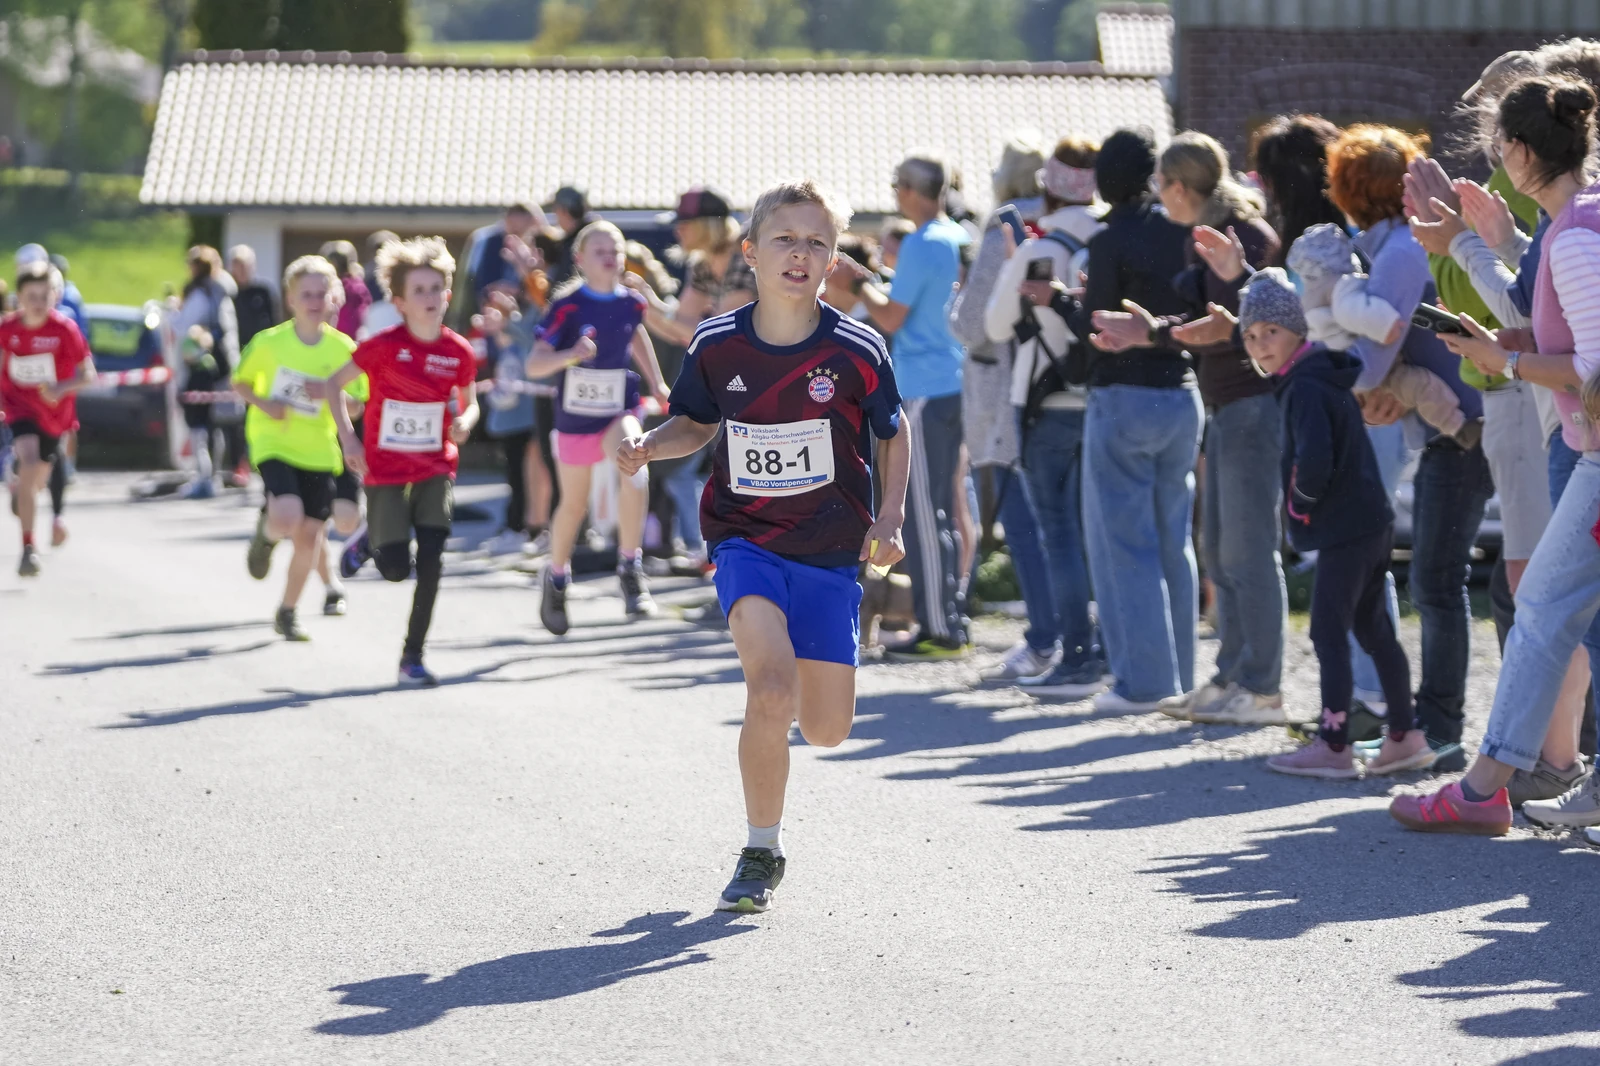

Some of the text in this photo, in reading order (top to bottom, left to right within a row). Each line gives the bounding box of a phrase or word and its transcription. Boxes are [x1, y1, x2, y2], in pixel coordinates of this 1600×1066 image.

[393, 418, 433, 435] 63-1
[751, 429, 815, 441] Allgäu-Oberschwaben
[745, 445, 811, 475] 88-1
[750, 478, 813, 488] VBAO Voralpencup
